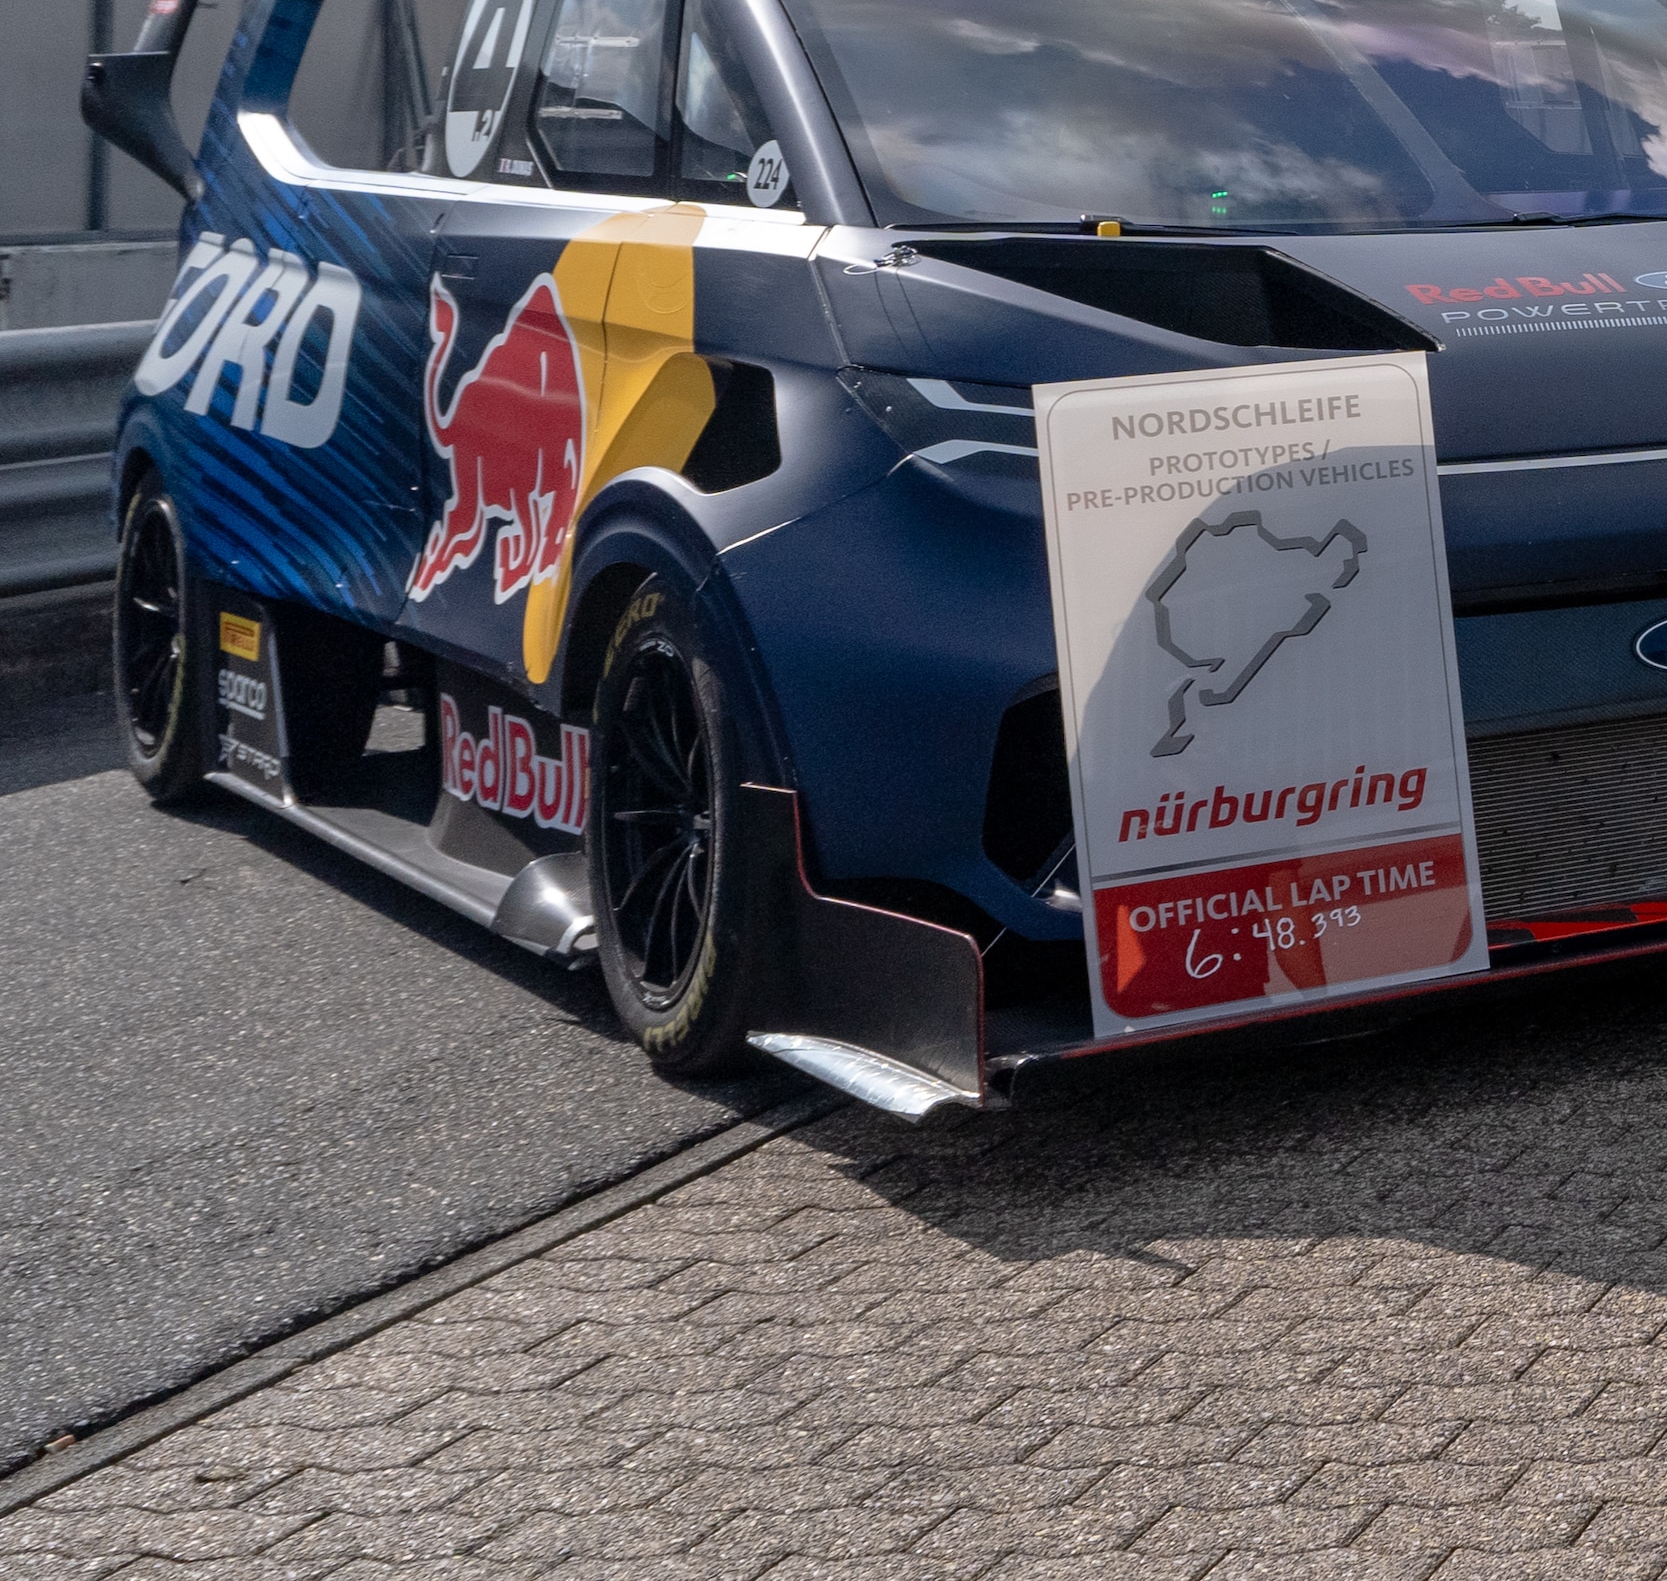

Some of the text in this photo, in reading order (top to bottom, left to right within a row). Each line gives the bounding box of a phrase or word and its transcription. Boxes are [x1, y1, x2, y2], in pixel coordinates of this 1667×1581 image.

[753, 158, 782, 189] 224
[1404, 271, 1627, 306] Red Bull
[134, 231, 361, 449] FORD
[1112, 394, 1361, 440] NORDSCHLEIFE
[1066, 458, 1414, 511] PRE-PRODUCTION VEHICLES
[1149, 442, 1312, 476] PROTOTYPES
[218, 669, 267, 719] sparco
[440, 692, 590, 835] Red Bull
[1118, 765, 1427, 842] nürburgring
[1129, 860, 1435, 932] OFFICIAL LAP TIME
